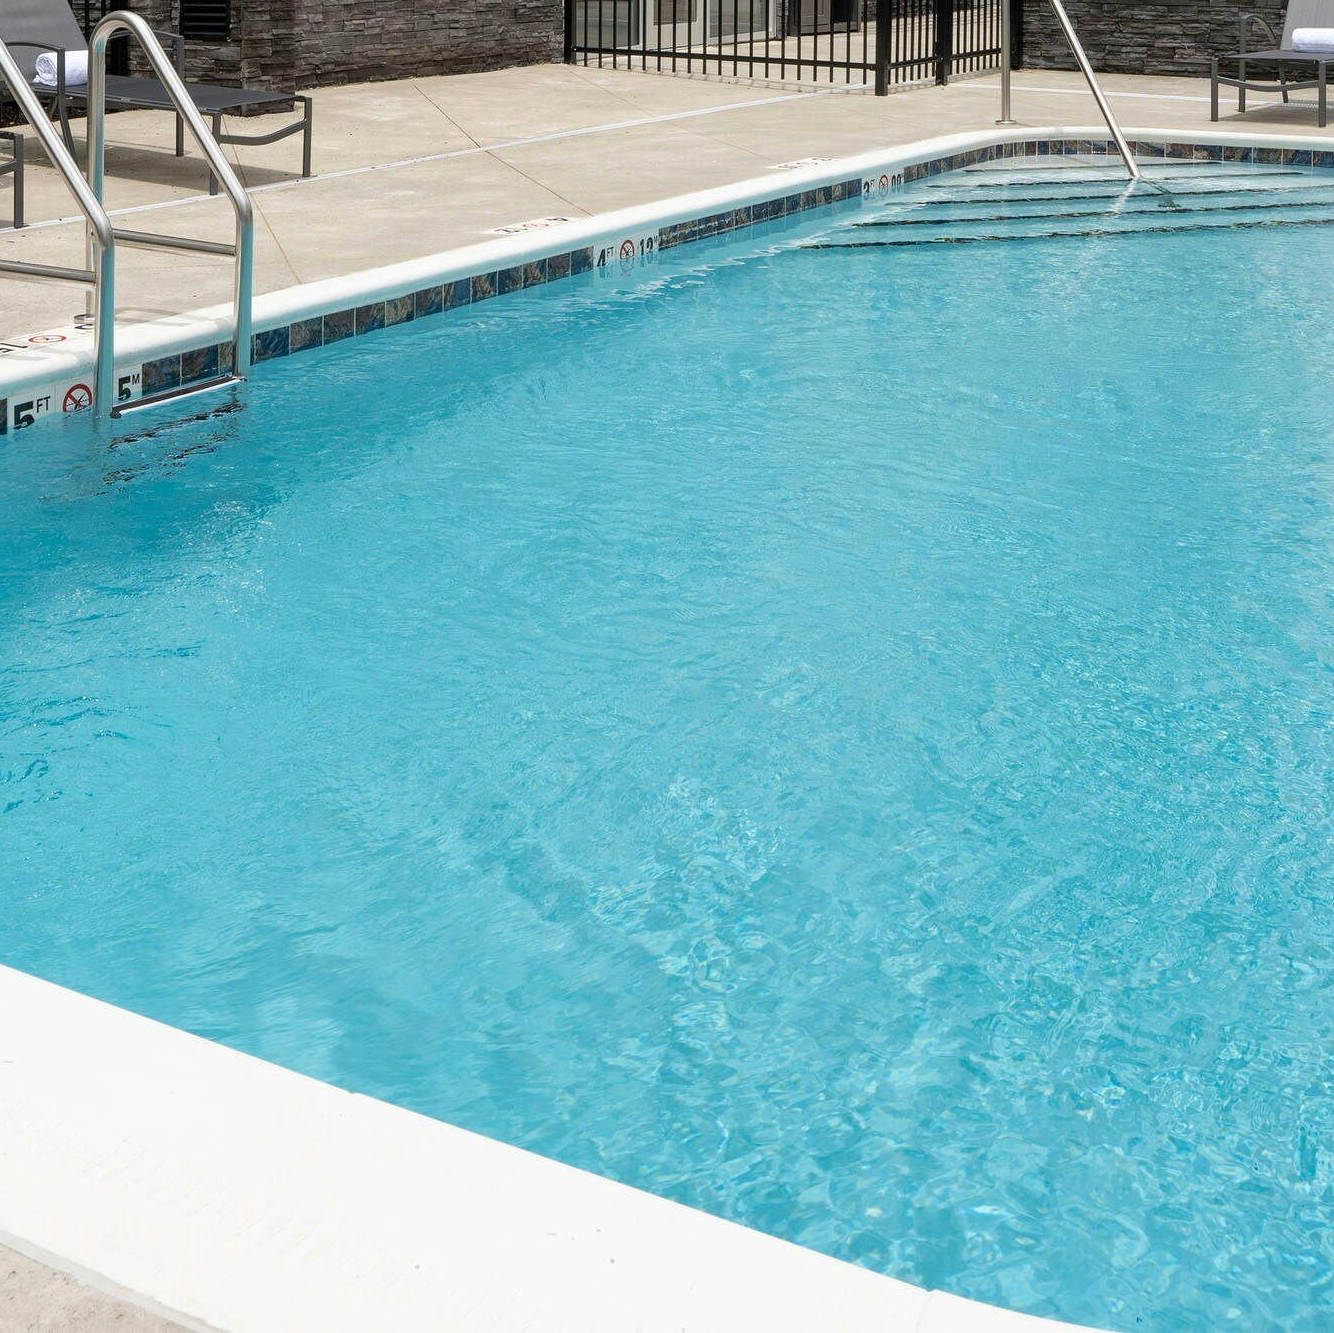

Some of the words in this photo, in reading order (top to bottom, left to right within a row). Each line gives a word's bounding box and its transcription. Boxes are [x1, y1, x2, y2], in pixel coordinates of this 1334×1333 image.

[131, 373, 140, 385] M
[14, 401, 35, 429] 5
[36, 396, 51, 413] FT
